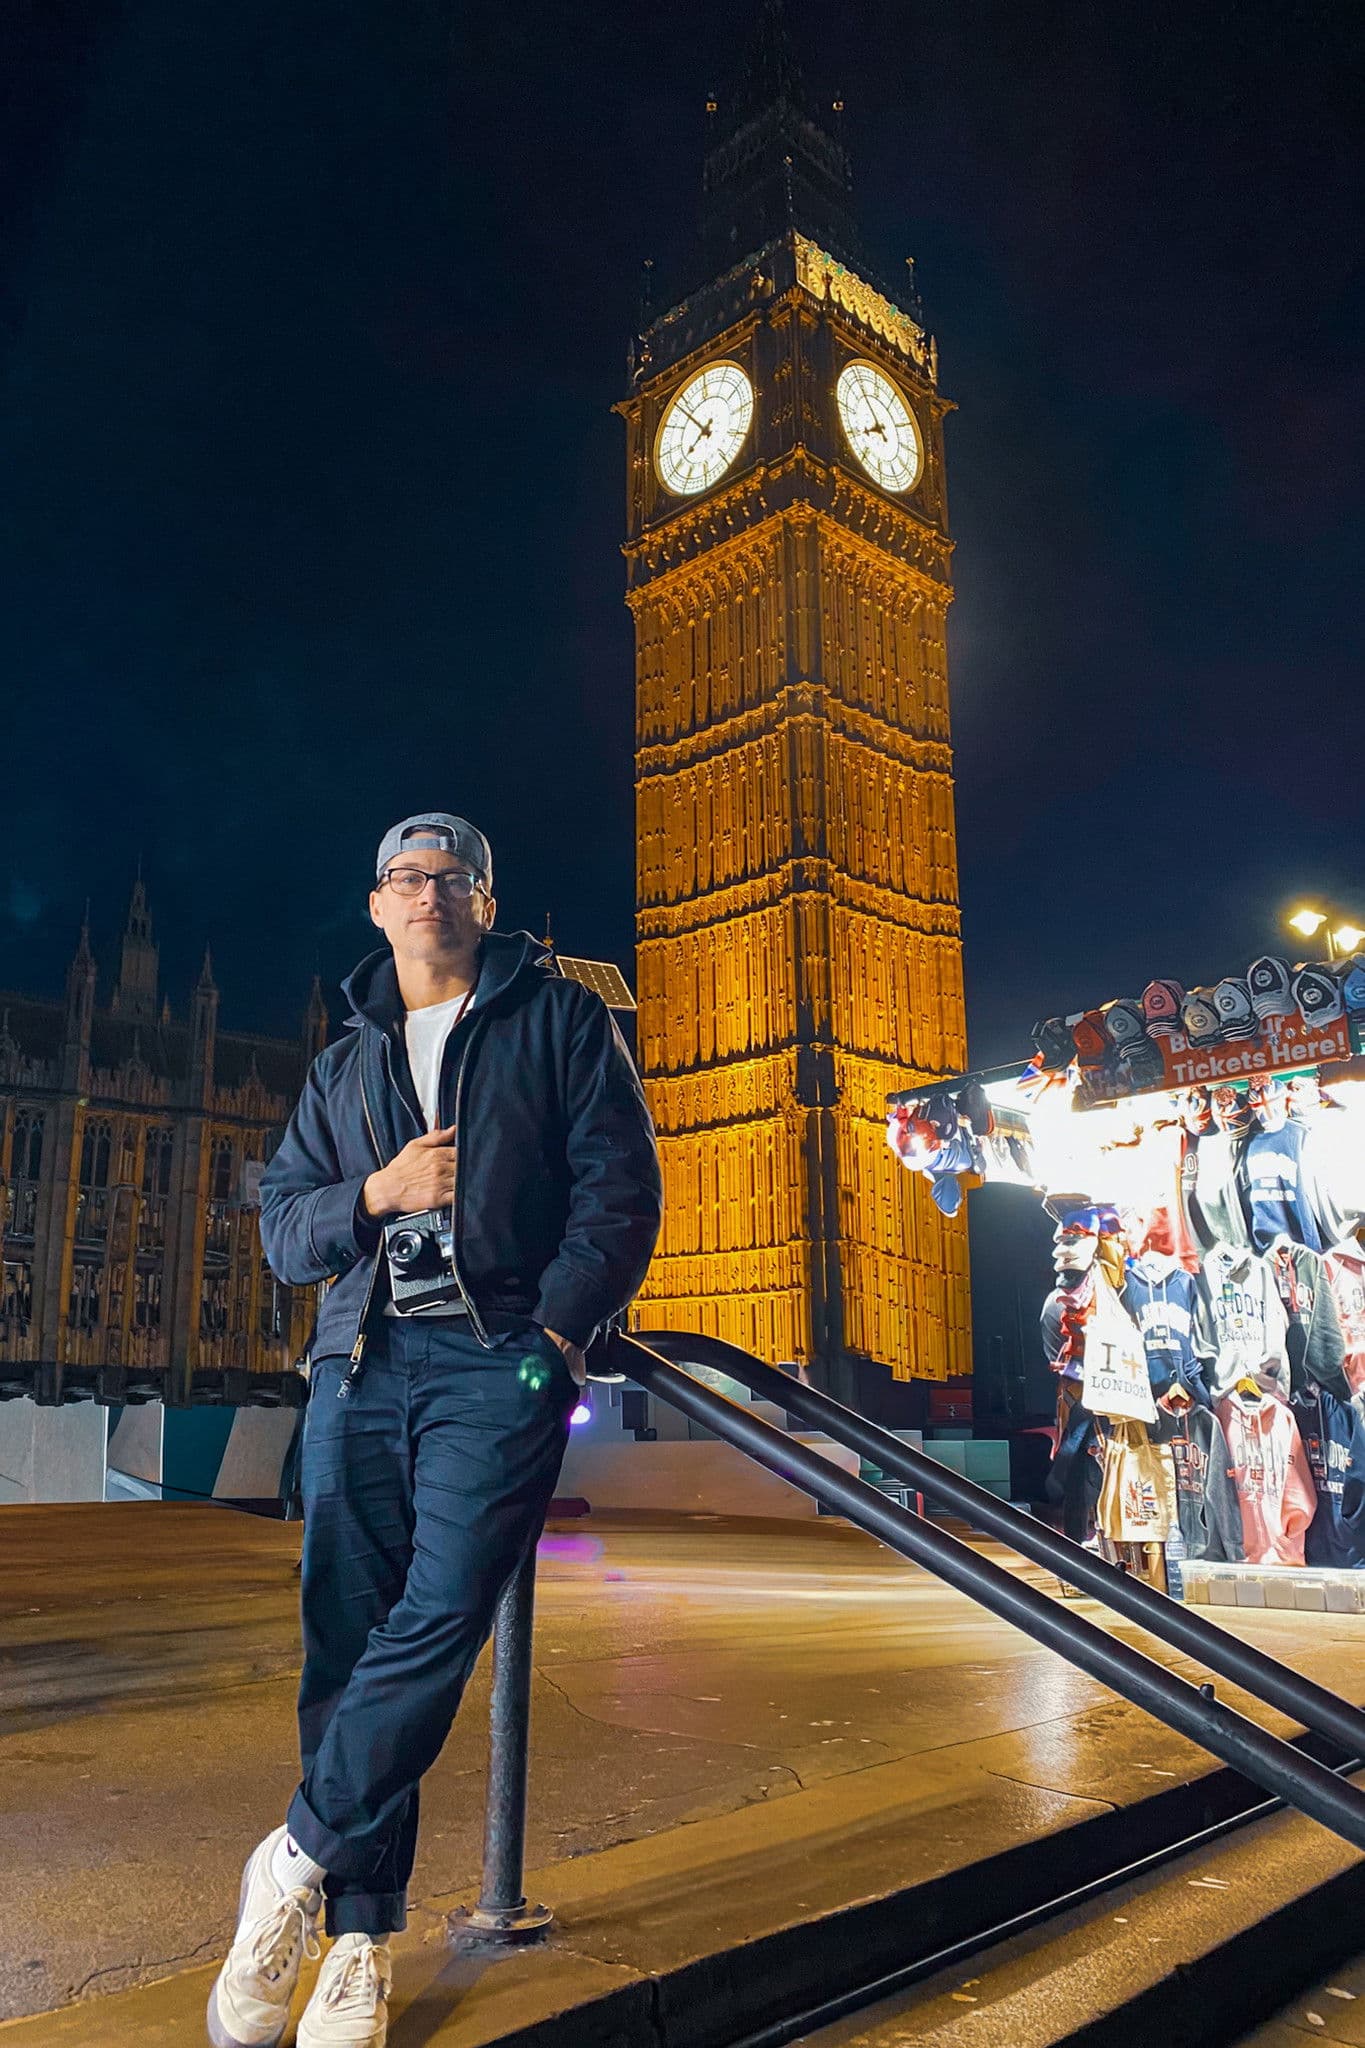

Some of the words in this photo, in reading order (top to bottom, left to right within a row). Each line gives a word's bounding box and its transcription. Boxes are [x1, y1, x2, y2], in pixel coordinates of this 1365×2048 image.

[1172, 1051, 1267, 1083] Tickets
[1271, 1031, 1346, 1065] Here!
[1100, 1342, 1117, 1373] I
[1091, 1375, 1148, 1399] LONDON
